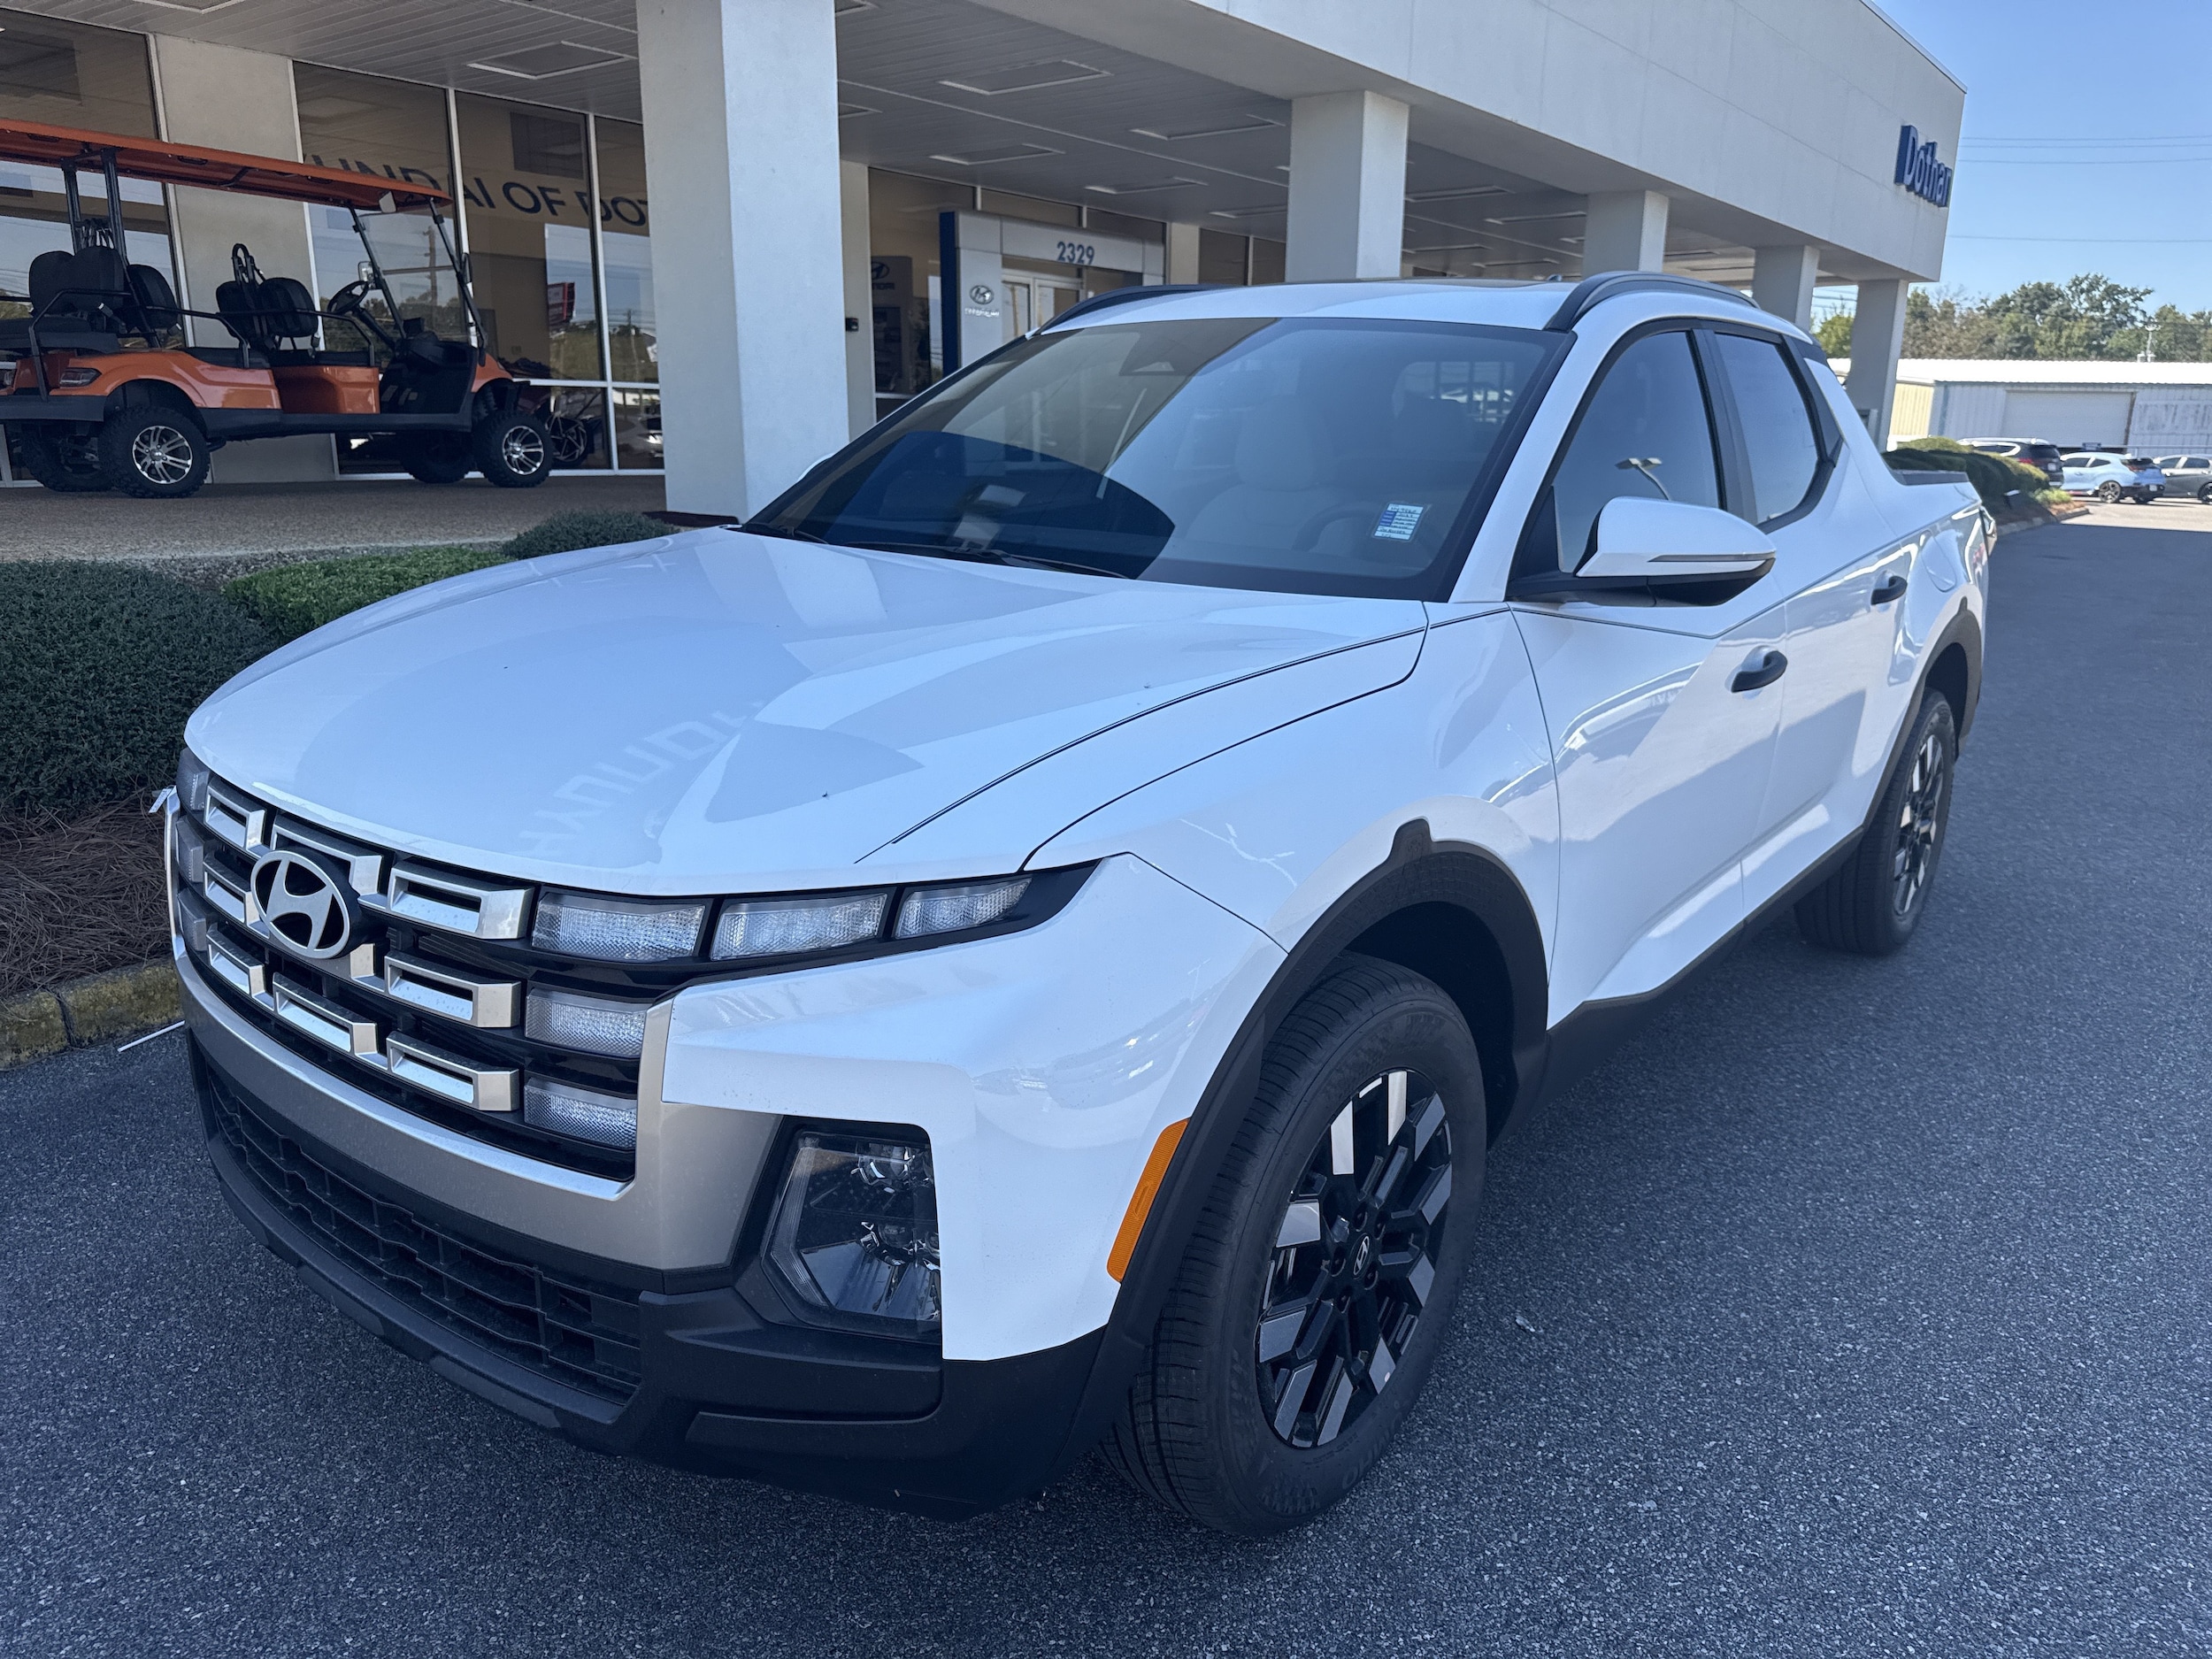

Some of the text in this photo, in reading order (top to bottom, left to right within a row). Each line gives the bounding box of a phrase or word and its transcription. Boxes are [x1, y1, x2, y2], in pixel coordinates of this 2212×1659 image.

[502, 181, 565, 216] OF
[574, 191, 648, 226] DO
[1056, 241, 1094, 265] 2329
